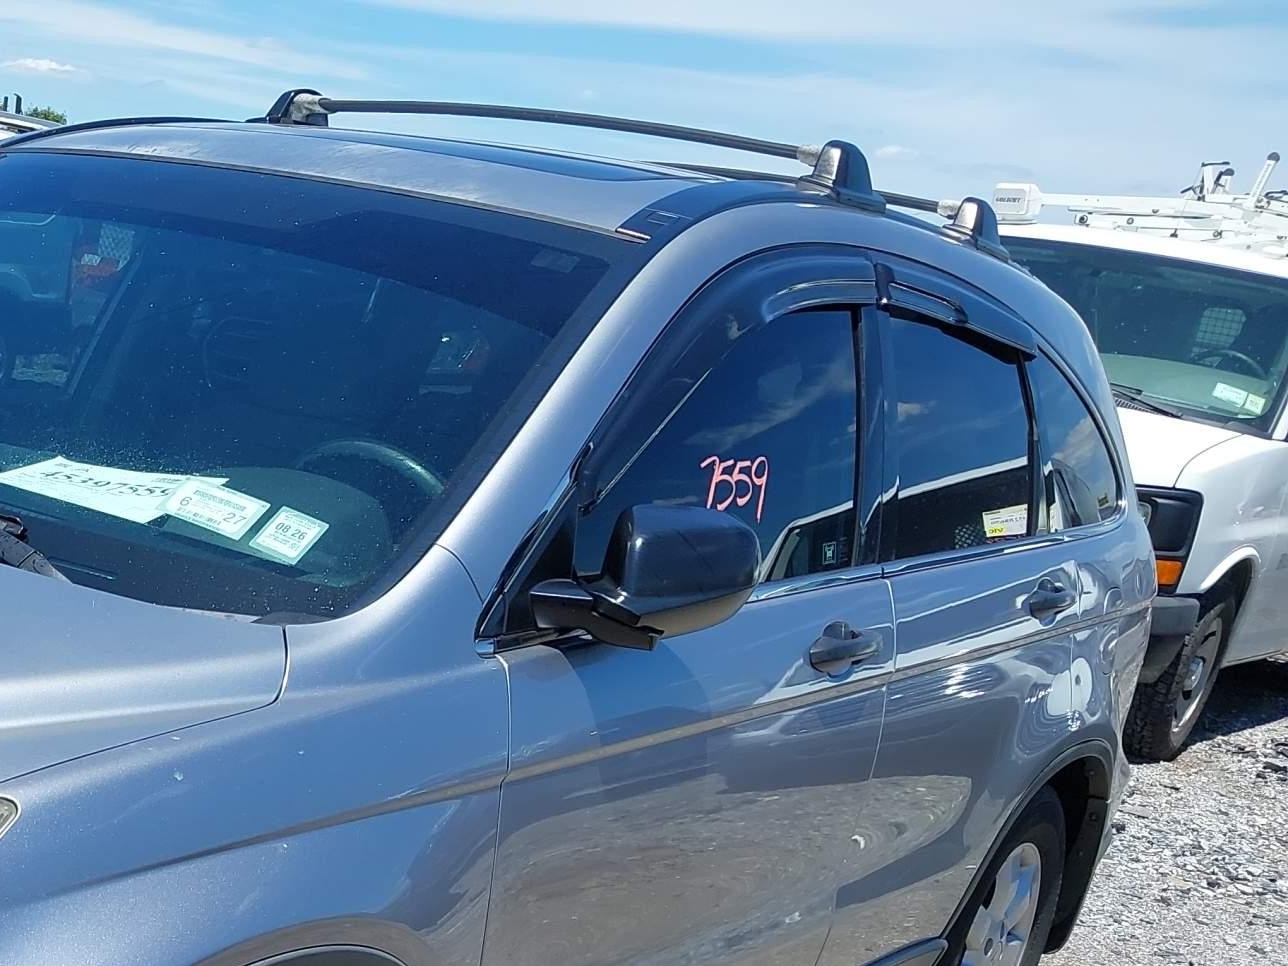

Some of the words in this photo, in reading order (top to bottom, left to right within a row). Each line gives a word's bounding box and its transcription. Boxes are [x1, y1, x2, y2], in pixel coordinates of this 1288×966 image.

[700, 455, 769, 524] 7559
[179, 496, 193, 507] 6
[222, 512, 248, 525] 27
[274, 522, 292, 534] 08
[291, 528, 308, 541] 26
